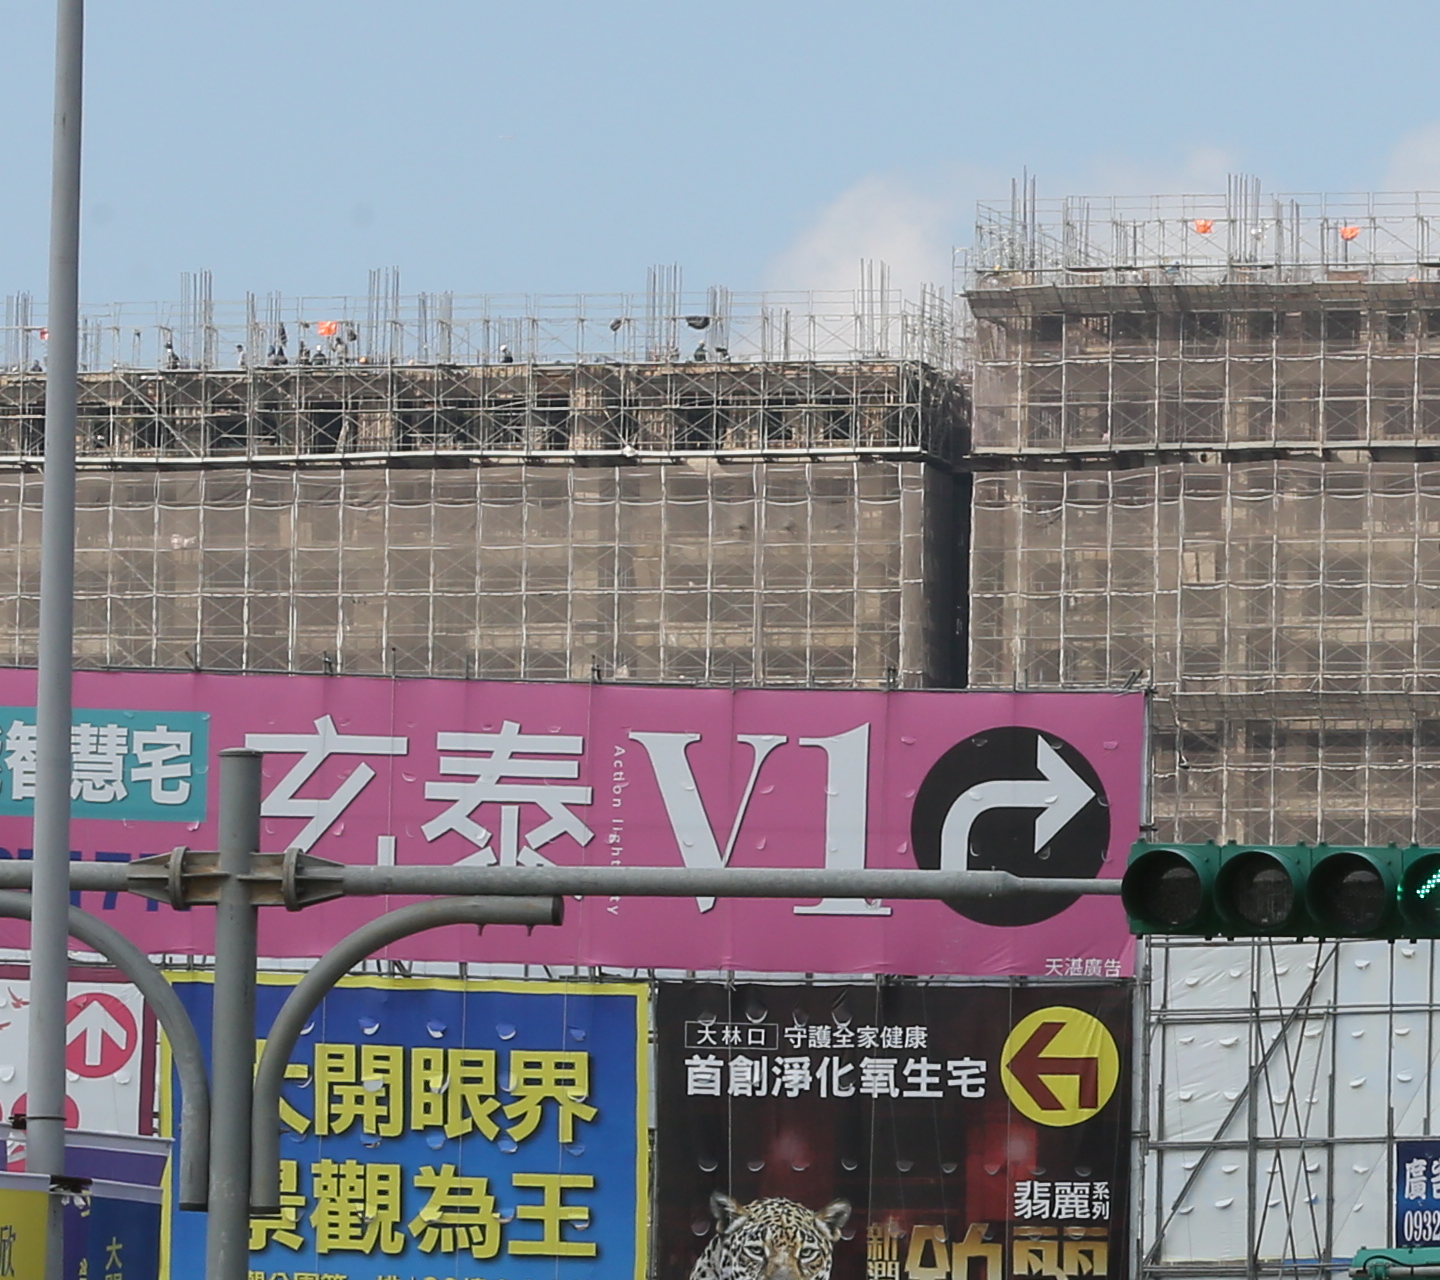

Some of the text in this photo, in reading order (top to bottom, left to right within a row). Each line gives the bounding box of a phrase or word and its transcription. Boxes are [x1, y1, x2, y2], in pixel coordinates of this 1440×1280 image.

[612, 745, 626, 808] Action
[784, 1024, 928, 1051] 守護全家健康
[684, 1055, 988, 1100] 首創淨化氧生宅
